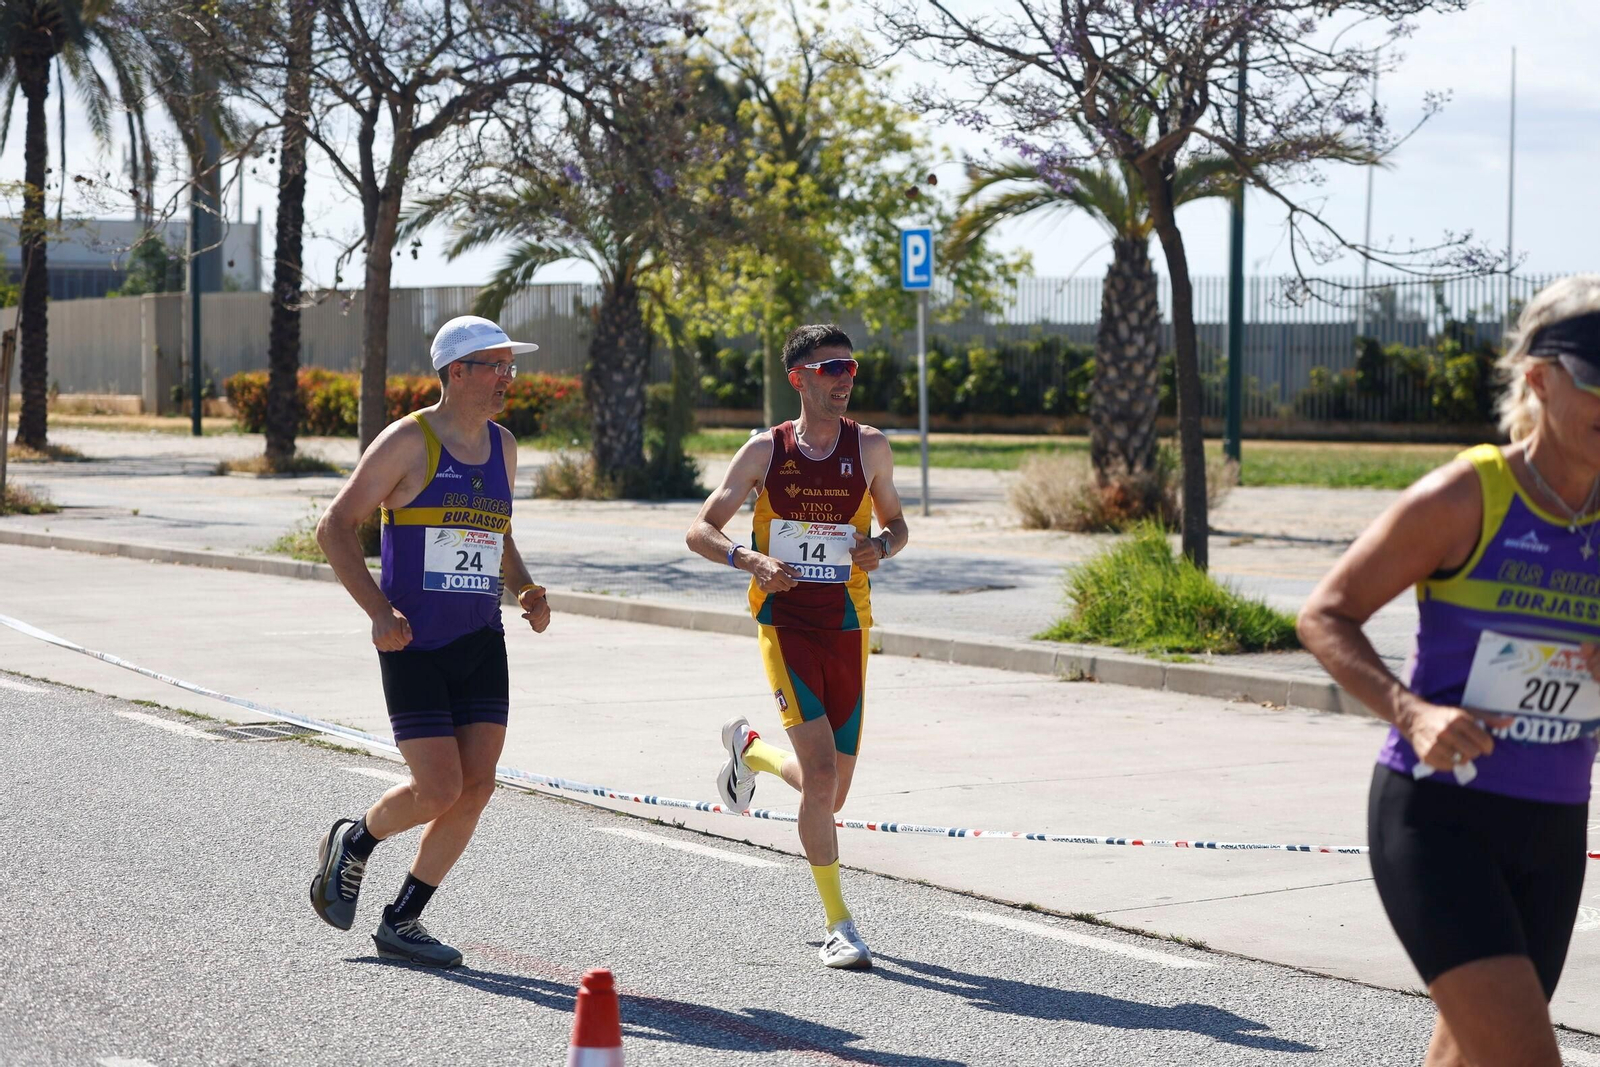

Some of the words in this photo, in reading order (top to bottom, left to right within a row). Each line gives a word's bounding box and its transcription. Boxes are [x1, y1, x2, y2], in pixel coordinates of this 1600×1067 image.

[906, 234, 927, 283] P
[802, 488, 823, 496] CAJA
[824, 488, 850, 497] RURAL
[443, 493, 468, 507] ELS
[472, 496, 510, 515] SITGES
[801, 502, 833, 512] VINO
[442, 511, 508, 530] BURJASSOT
[790, 512, 806, 520] DE
[808, 512, 842, 522] TORO
[455, 550, 483, 571] 24
[799, 542, 826, 562] 14
[789, 564, 837, 579] oma
[1519, 678, 1580, 714] 207
